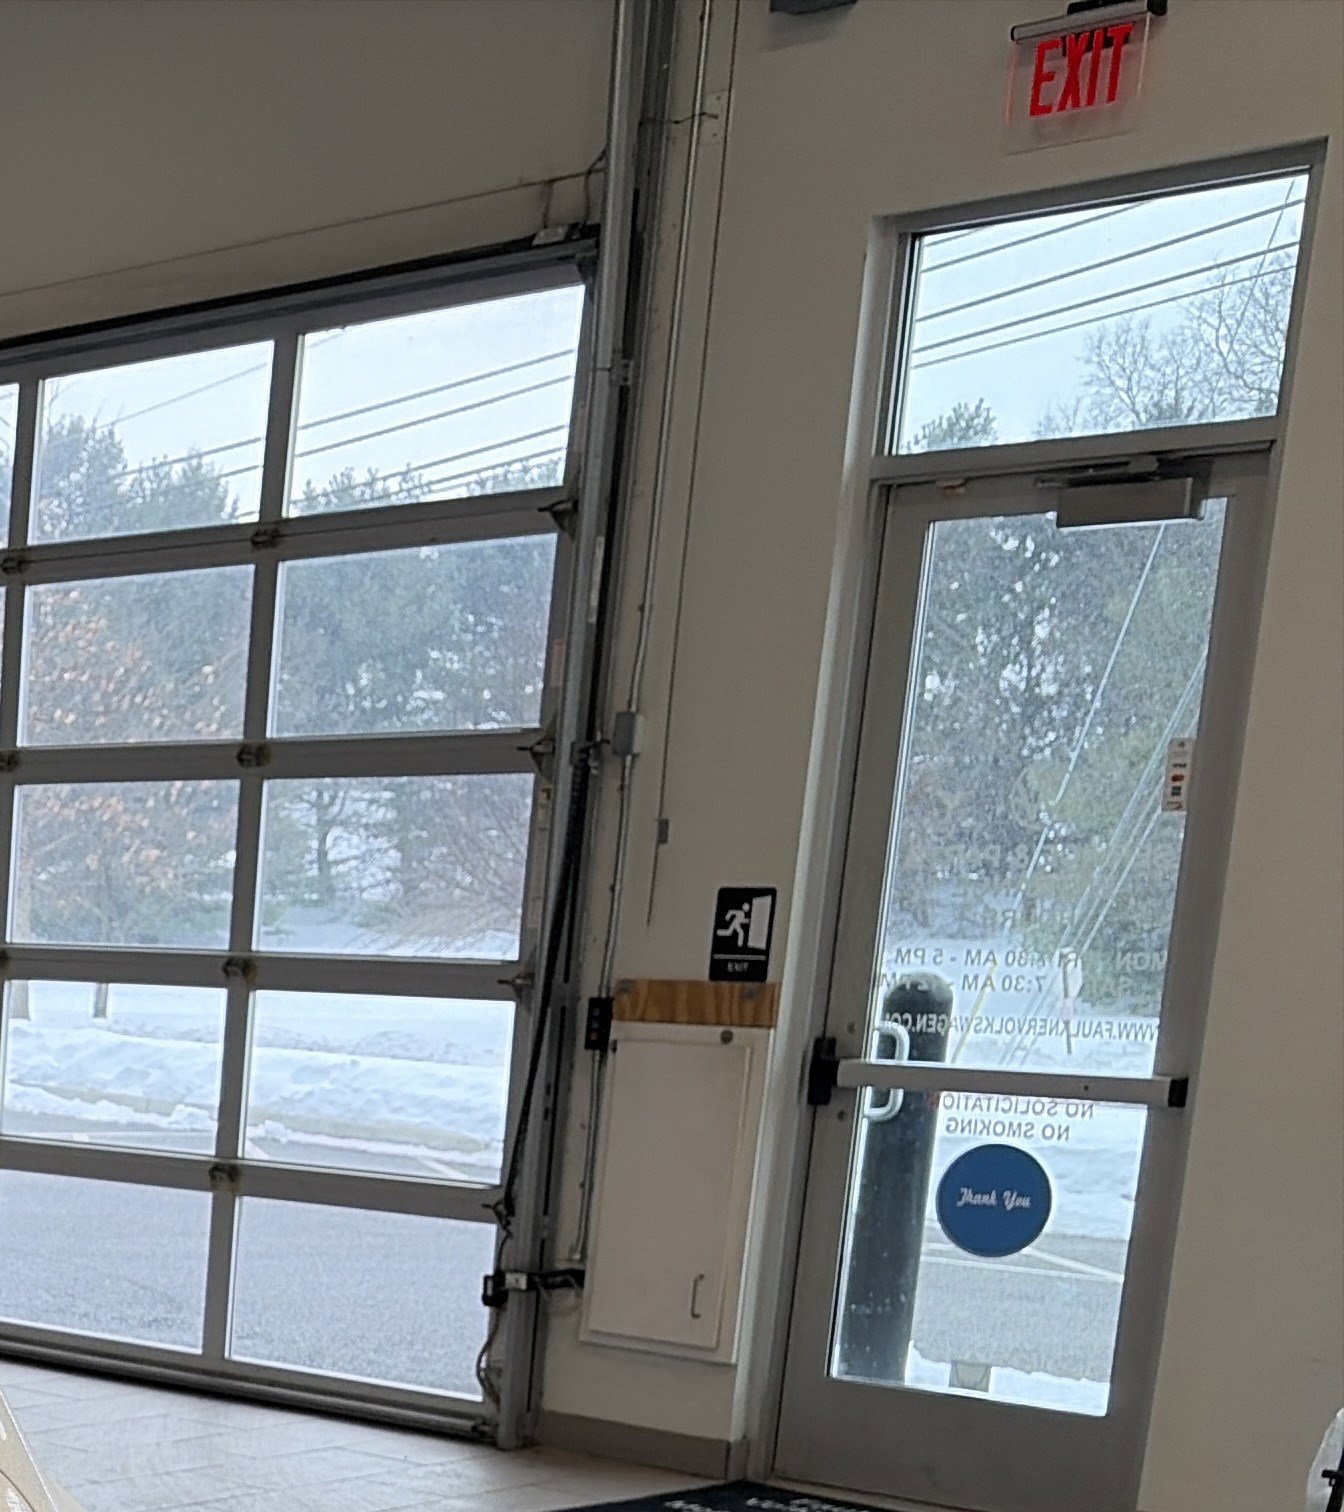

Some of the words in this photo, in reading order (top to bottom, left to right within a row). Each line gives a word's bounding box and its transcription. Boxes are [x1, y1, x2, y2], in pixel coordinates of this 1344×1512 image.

[1029, 23, 1133, 117] EXIT
[957, 1187, 997, 1209] Thank
[999, 1190, 1033, 1211] You
